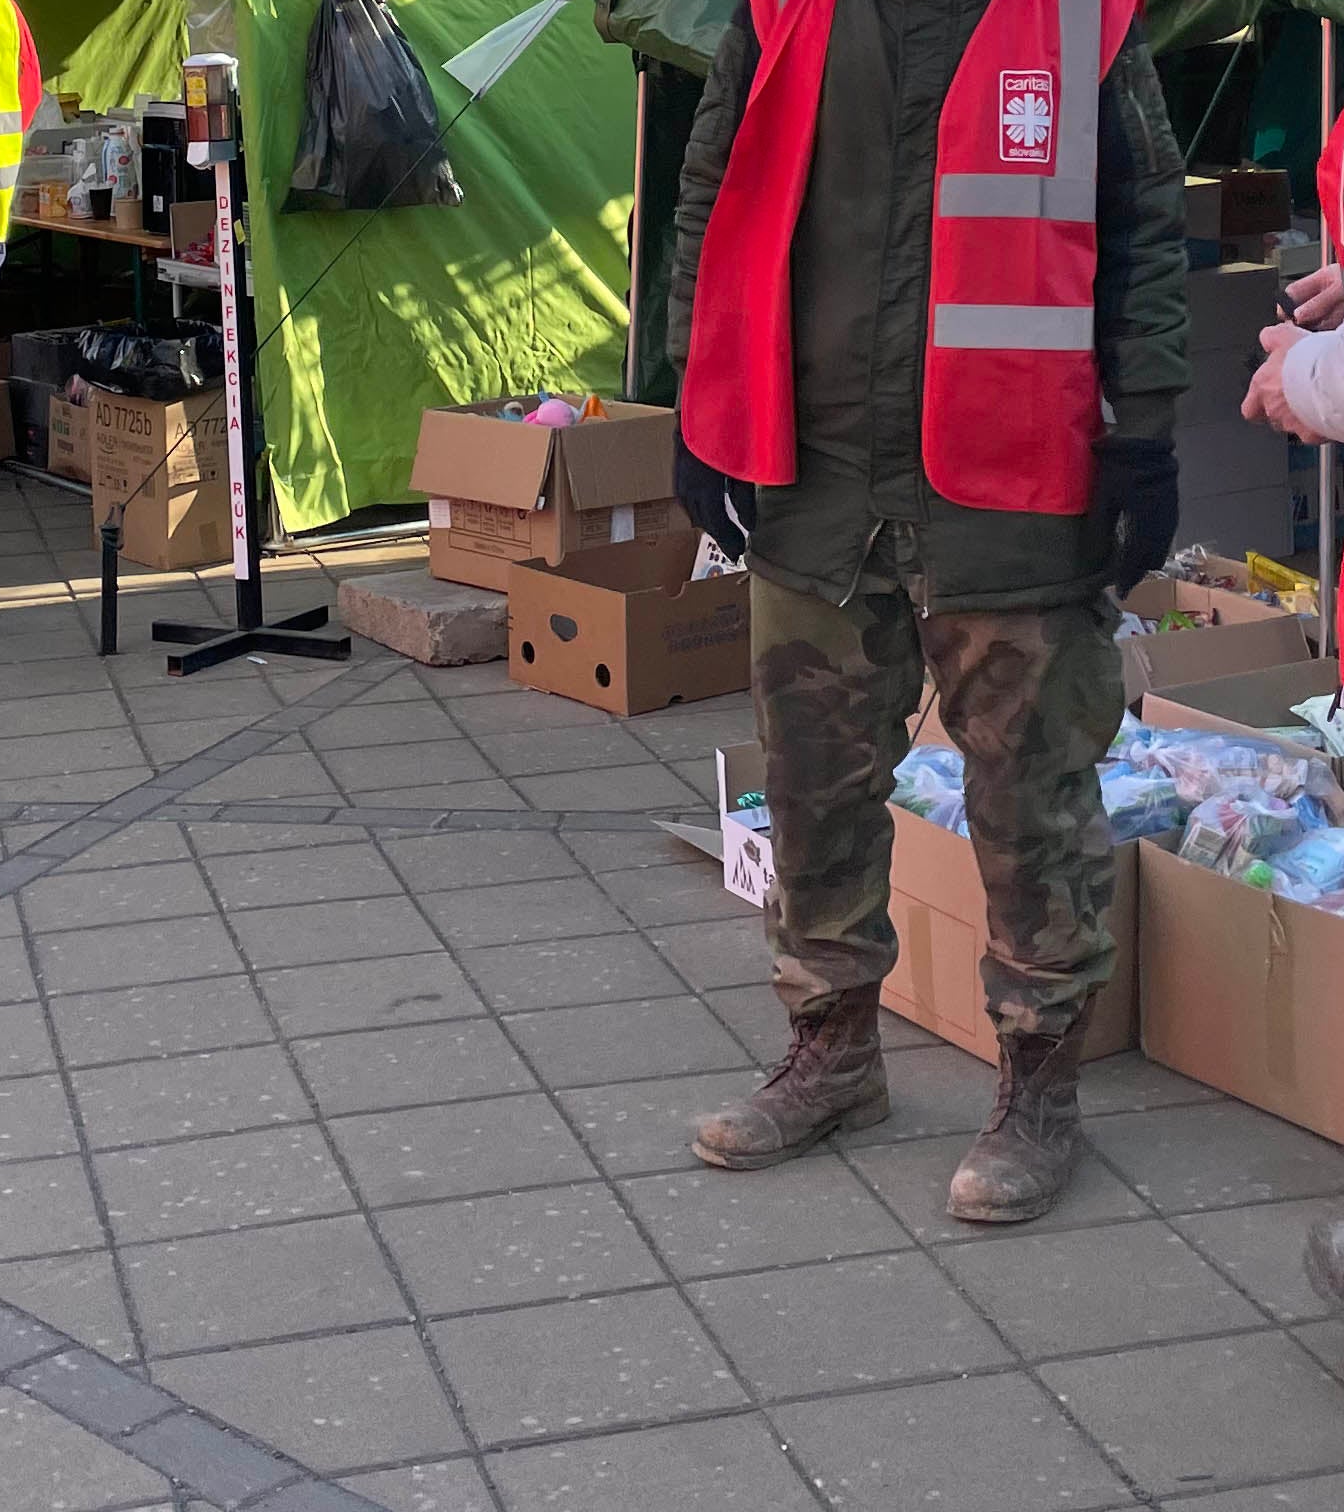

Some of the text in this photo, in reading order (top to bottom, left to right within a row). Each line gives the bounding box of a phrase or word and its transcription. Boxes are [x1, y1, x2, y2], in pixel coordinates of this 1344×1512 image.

[1005, 76, 1049, 91] caritas
[219, 196, 240, 431] DEZINFEKCIA
[96, 400, 152, 437] AD 7725b
[201, 417, 228, 437] 772
